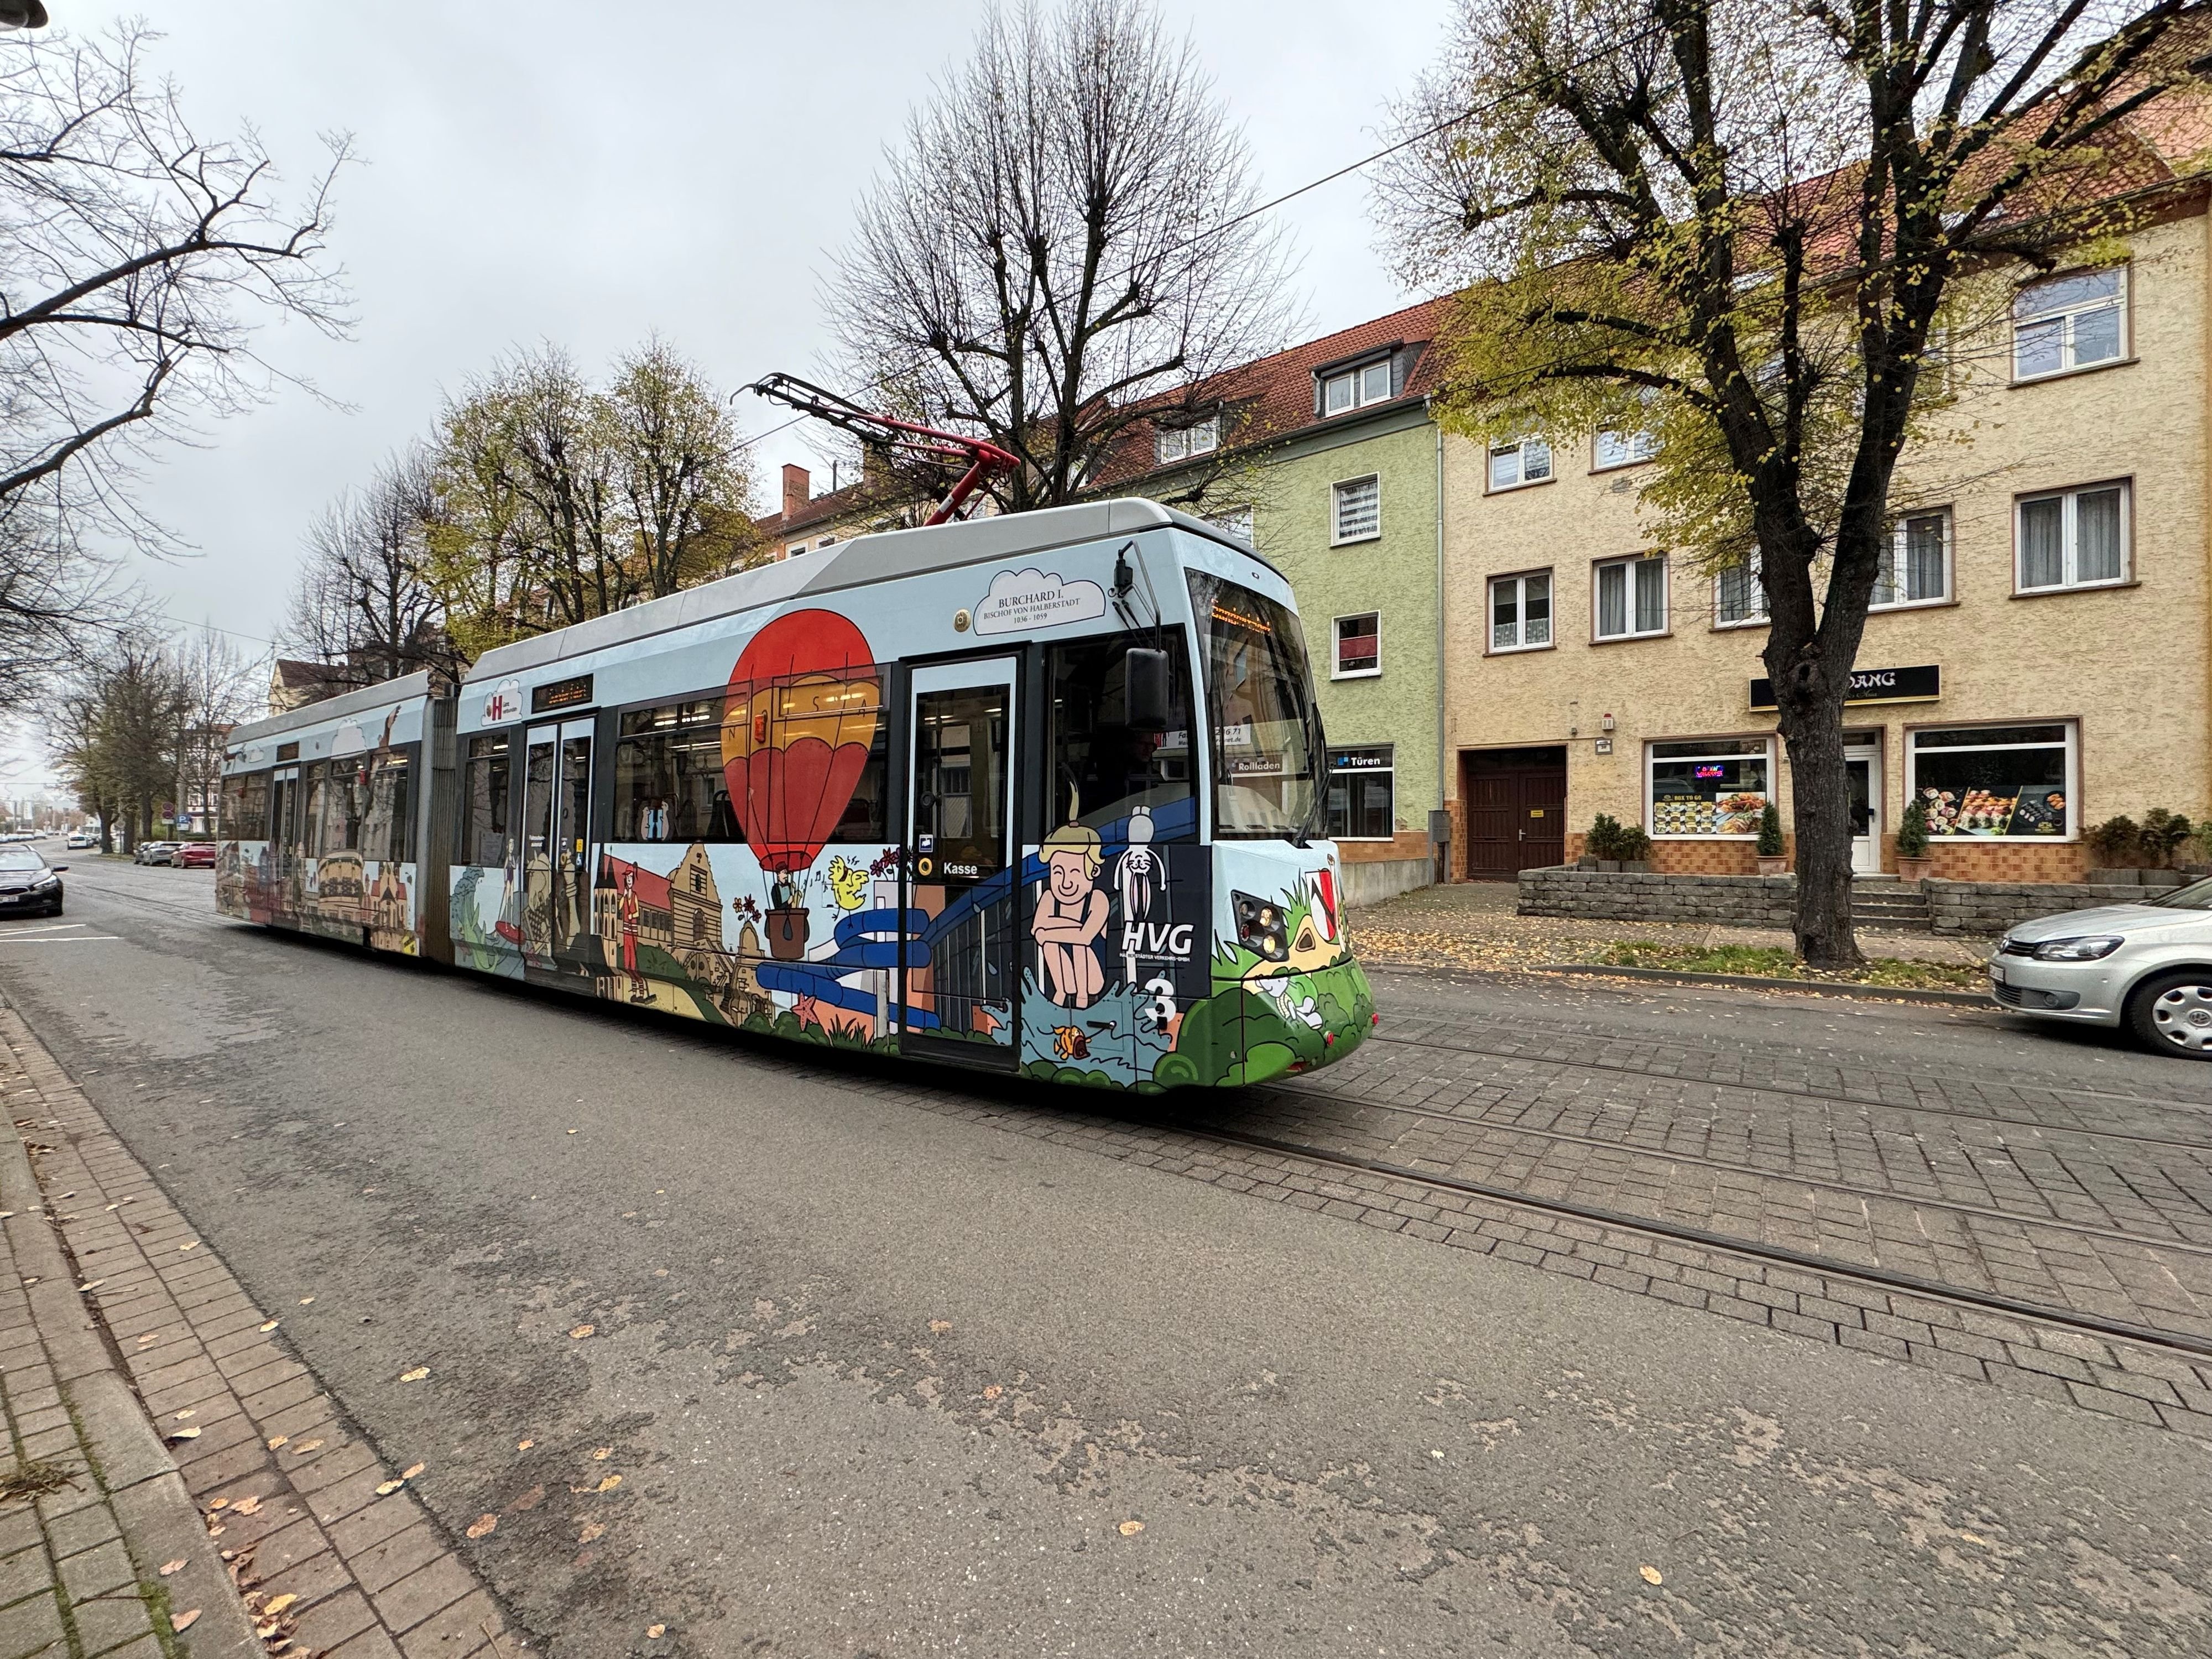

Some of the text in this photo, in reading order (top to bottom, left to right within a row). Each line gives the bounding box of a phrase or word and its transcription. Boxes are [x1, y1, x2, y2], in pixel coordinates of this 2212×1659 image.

[999, 589, 1064, 608] BURCHARD I.
[984, 598, 1081, 620] BISCHOF VON HALBERSTADT
[1014, 615, 1028, 624] 1036
[1351, 757, 1380, 766] Türen
[943, 862, 978, 874] Kasse
[1122, 922, 1194, 955] HVG
[1144, 978, 1176, 1023] 3
